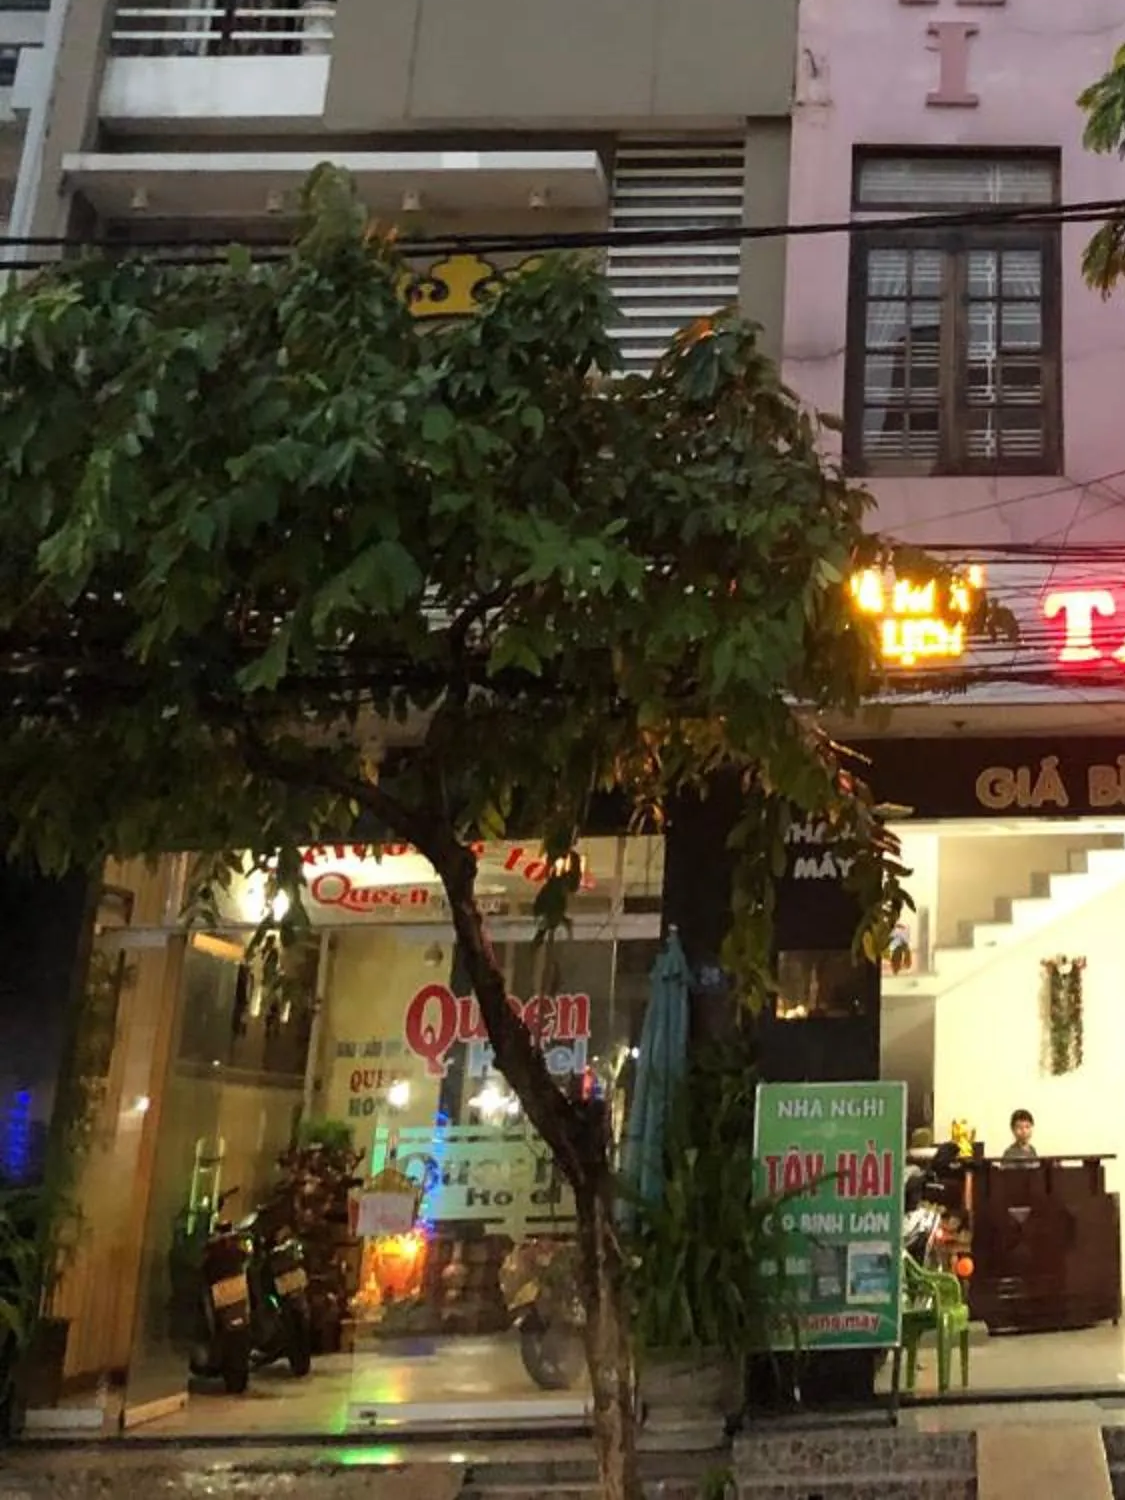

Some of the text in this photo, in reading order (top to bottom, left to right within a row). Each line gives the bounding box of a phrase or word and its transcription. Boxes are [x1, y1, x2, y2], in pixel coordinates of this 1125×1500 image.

[975, 755, 1069, 808] GIÁ
[312, 871, 429, 913] Queen
[405, 981, 592, 1078] Quen
[466, 1187, 562, 1207] Hoel
